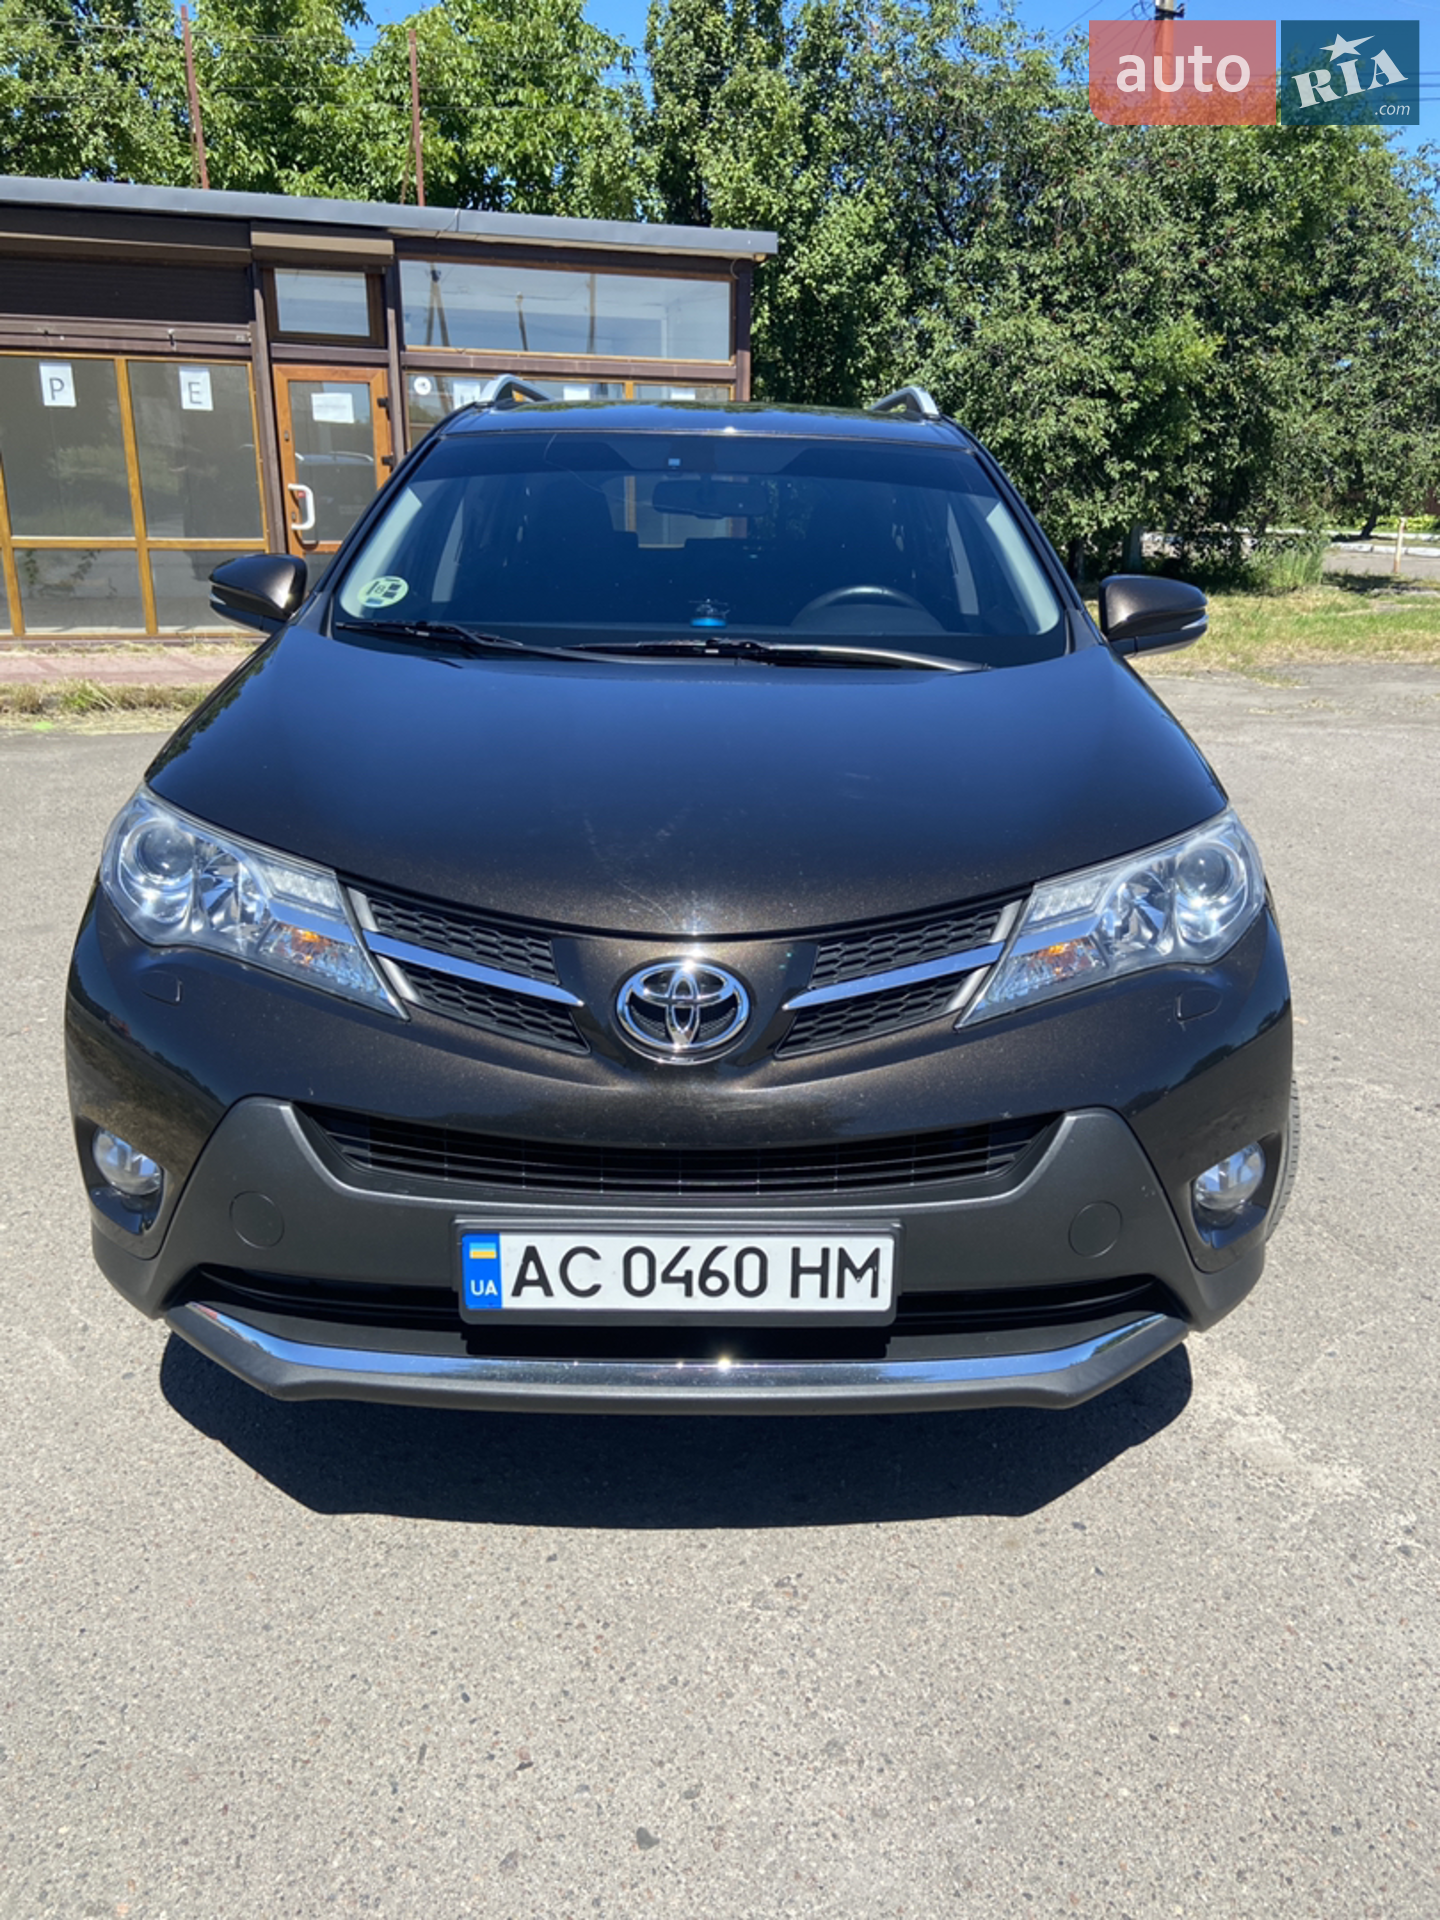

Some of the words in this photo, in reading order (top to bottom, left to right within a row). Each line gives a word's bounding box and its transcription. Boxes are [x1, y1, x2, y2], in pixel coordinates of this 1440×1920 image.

[470, 1279, 498, 1296] UA
[511, 1245, 602, 1298] AC
[622, 1245, 768, 1298] 0460
[790, 1247, 880, 1299] HM
